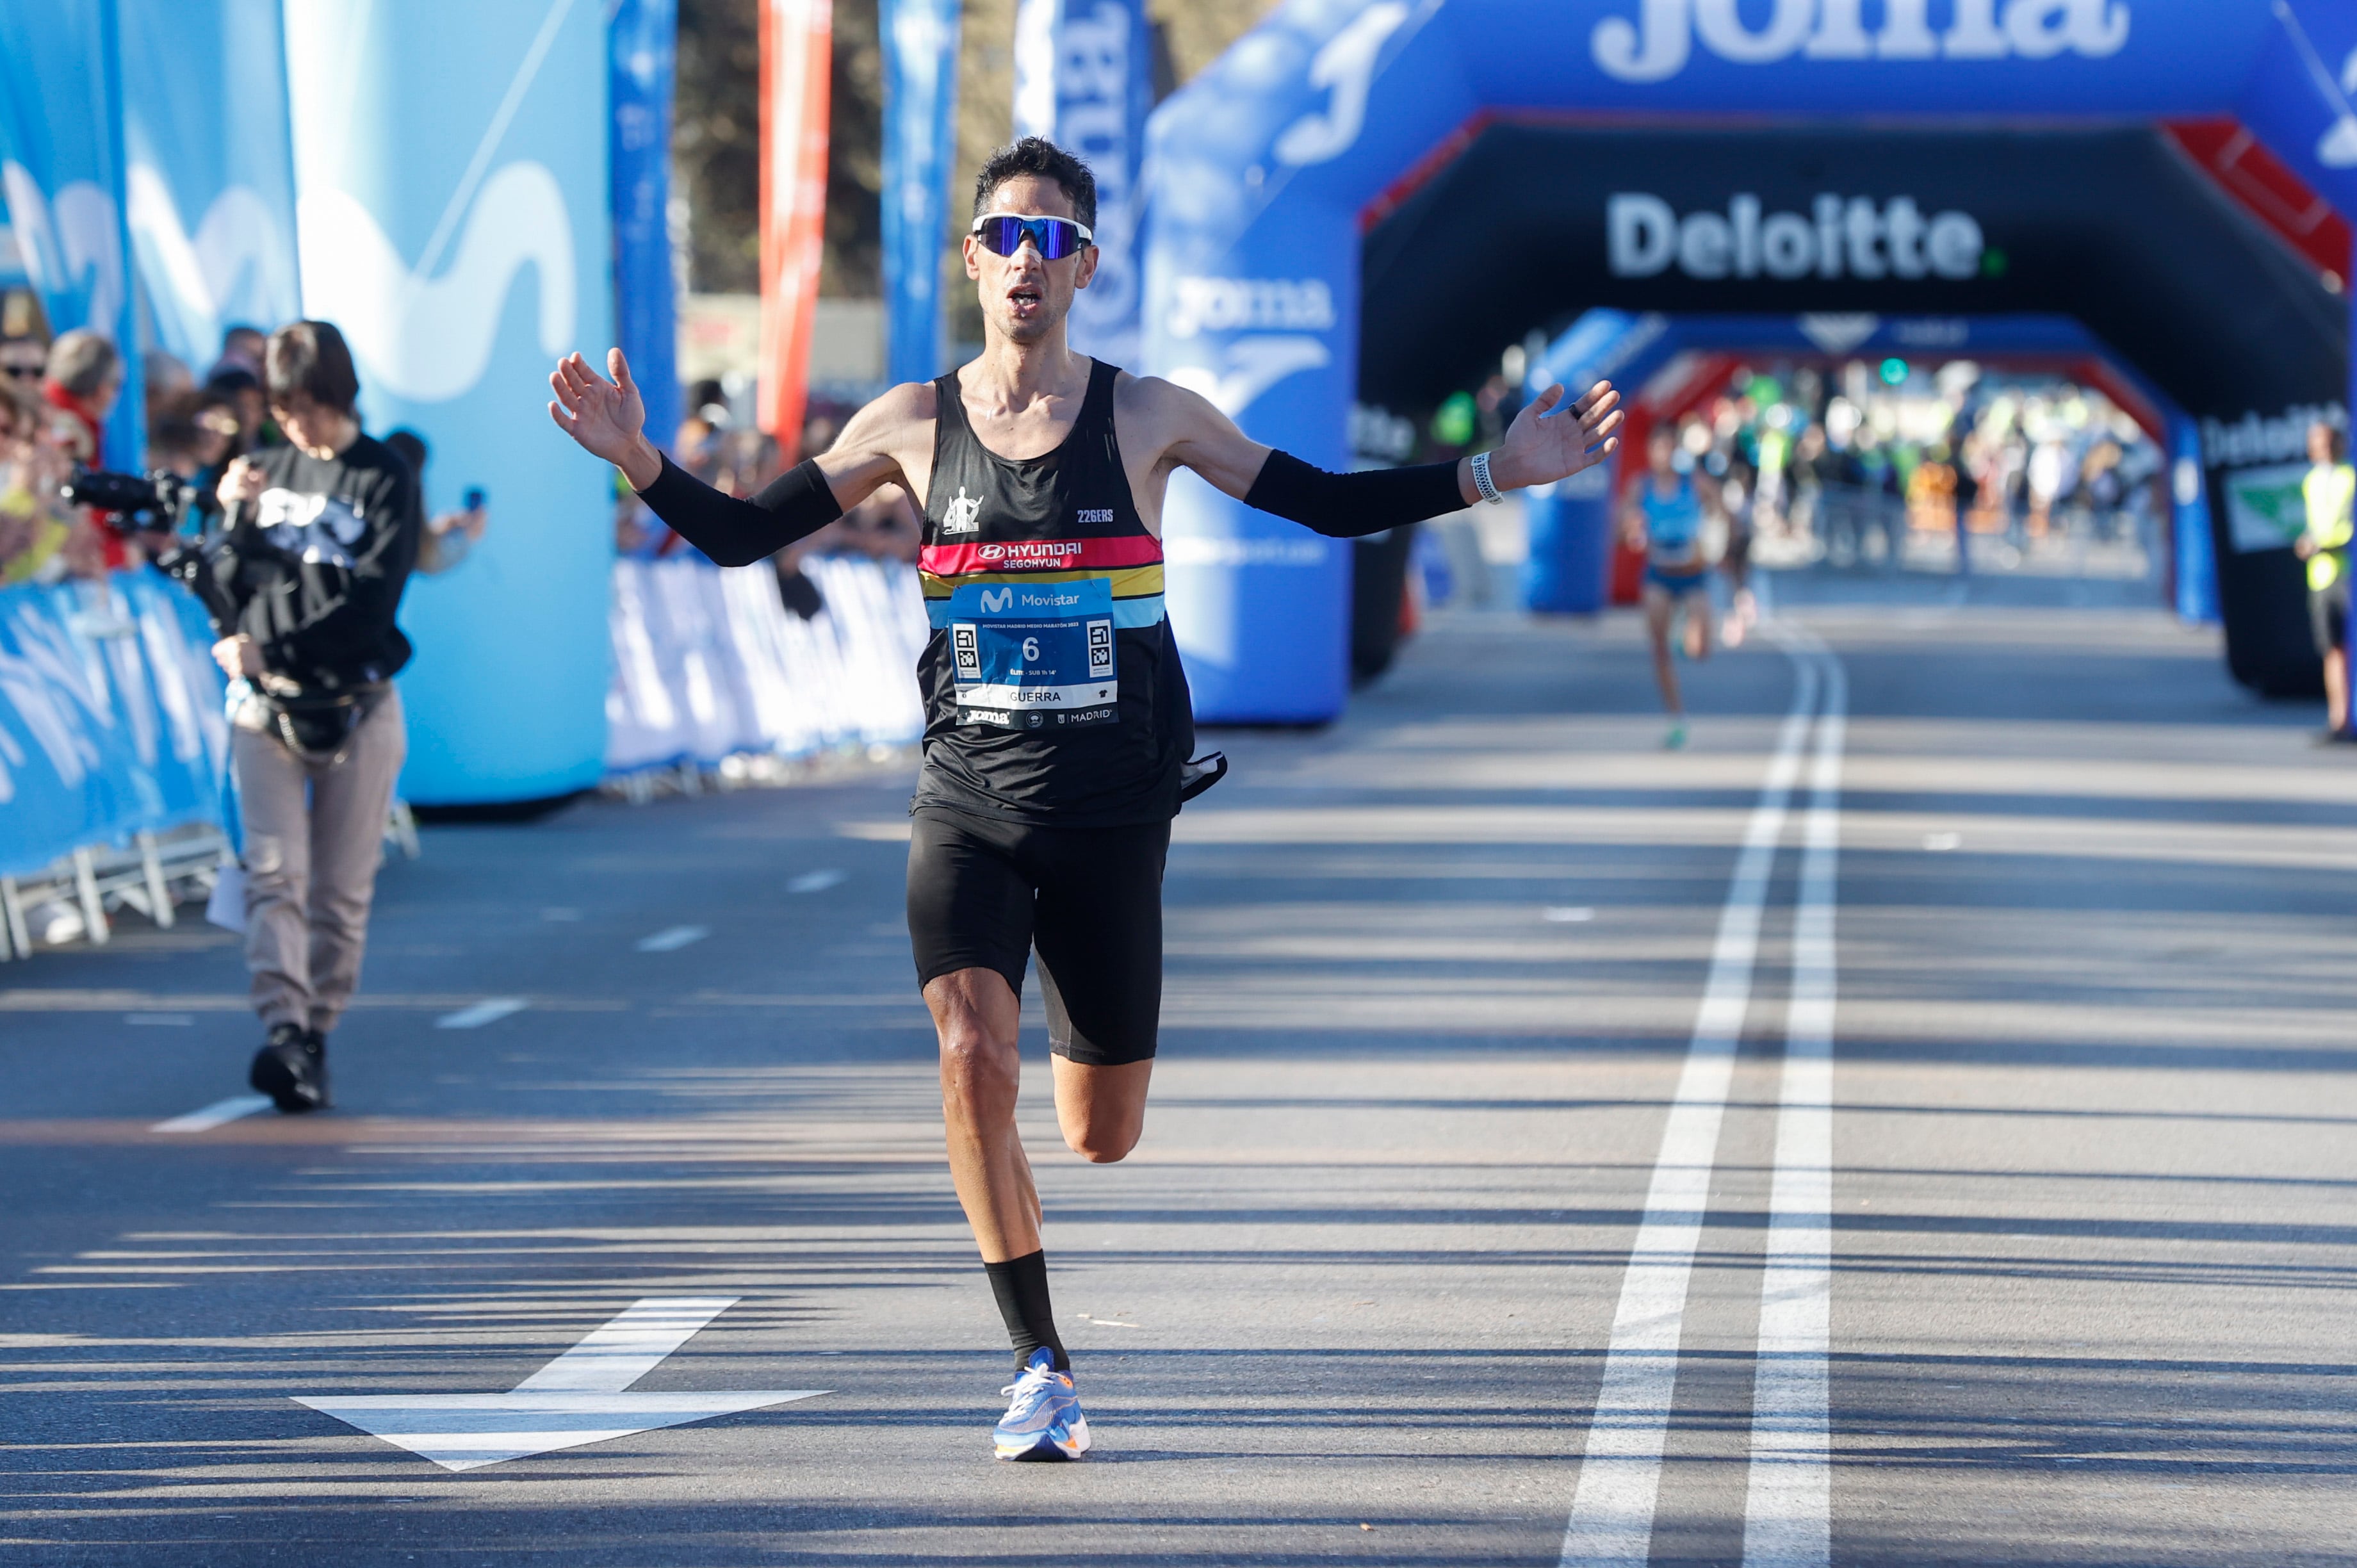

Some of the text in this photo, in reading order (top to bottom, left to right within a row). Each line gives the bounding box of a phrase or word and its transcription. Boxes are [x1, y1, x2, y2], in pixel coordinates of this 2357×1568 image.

[1077, 509, 1113, 523] 226ERS
[1007, 543, 1082, 557] HYUNDAI
[1003, 558, 1061, 569] SEGOHYUN
[1022, 594, 1080, 607] Movistar
[1023, 637, 1040, 661] 6
[1010, 692, 1061, 702] GUERRA
[1071, 709, 1111, 723] MADRID
